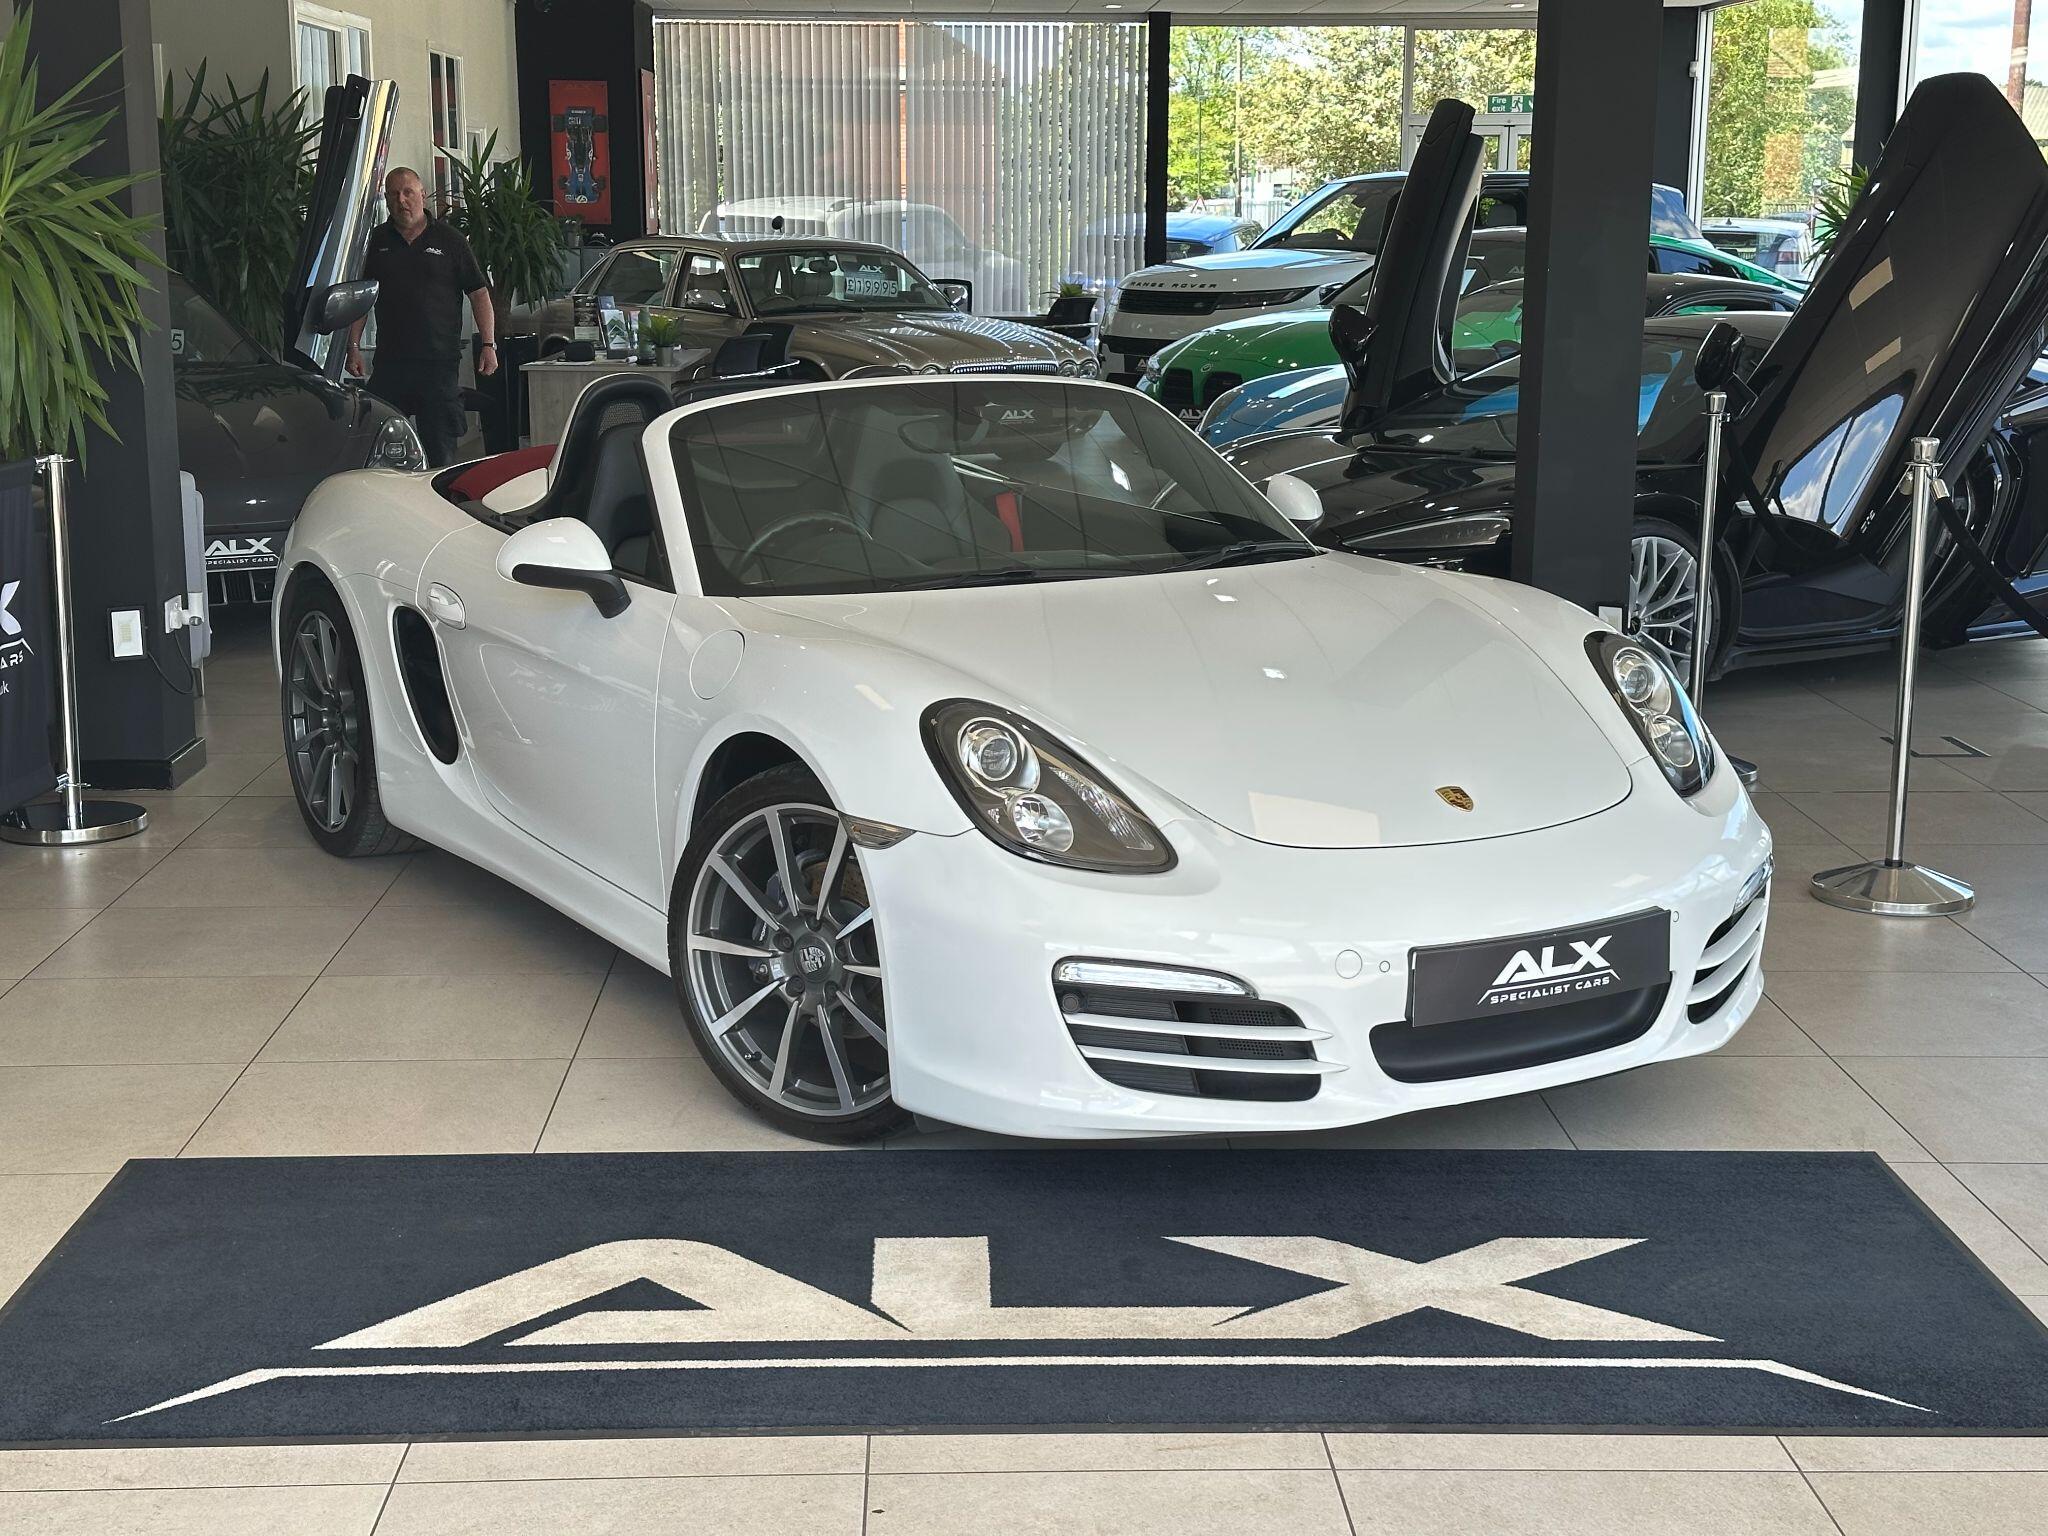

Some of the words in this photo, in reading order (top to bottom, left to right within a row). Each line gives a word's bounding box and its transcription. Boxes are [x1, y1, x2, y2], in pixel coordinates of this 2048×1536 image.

[1491, 96, 1507, 104] Fire
[858, 264, 883, 274] ALX
[847, 279, 898, 296] £19995
[1001, 409, 1035, 420] ALX
[1178, 408, 1207, 419] ALX
[205, 537, 274, 556] ALX
[0, 650, 24, 670] ARS
[1491, 934, 1613, 986] ALX
[1490, 984, 1571, 1004] SPECIALIST
[1575, 976, 1610, 990] CARS
[312, 1234, 1726, 1350] ALX
